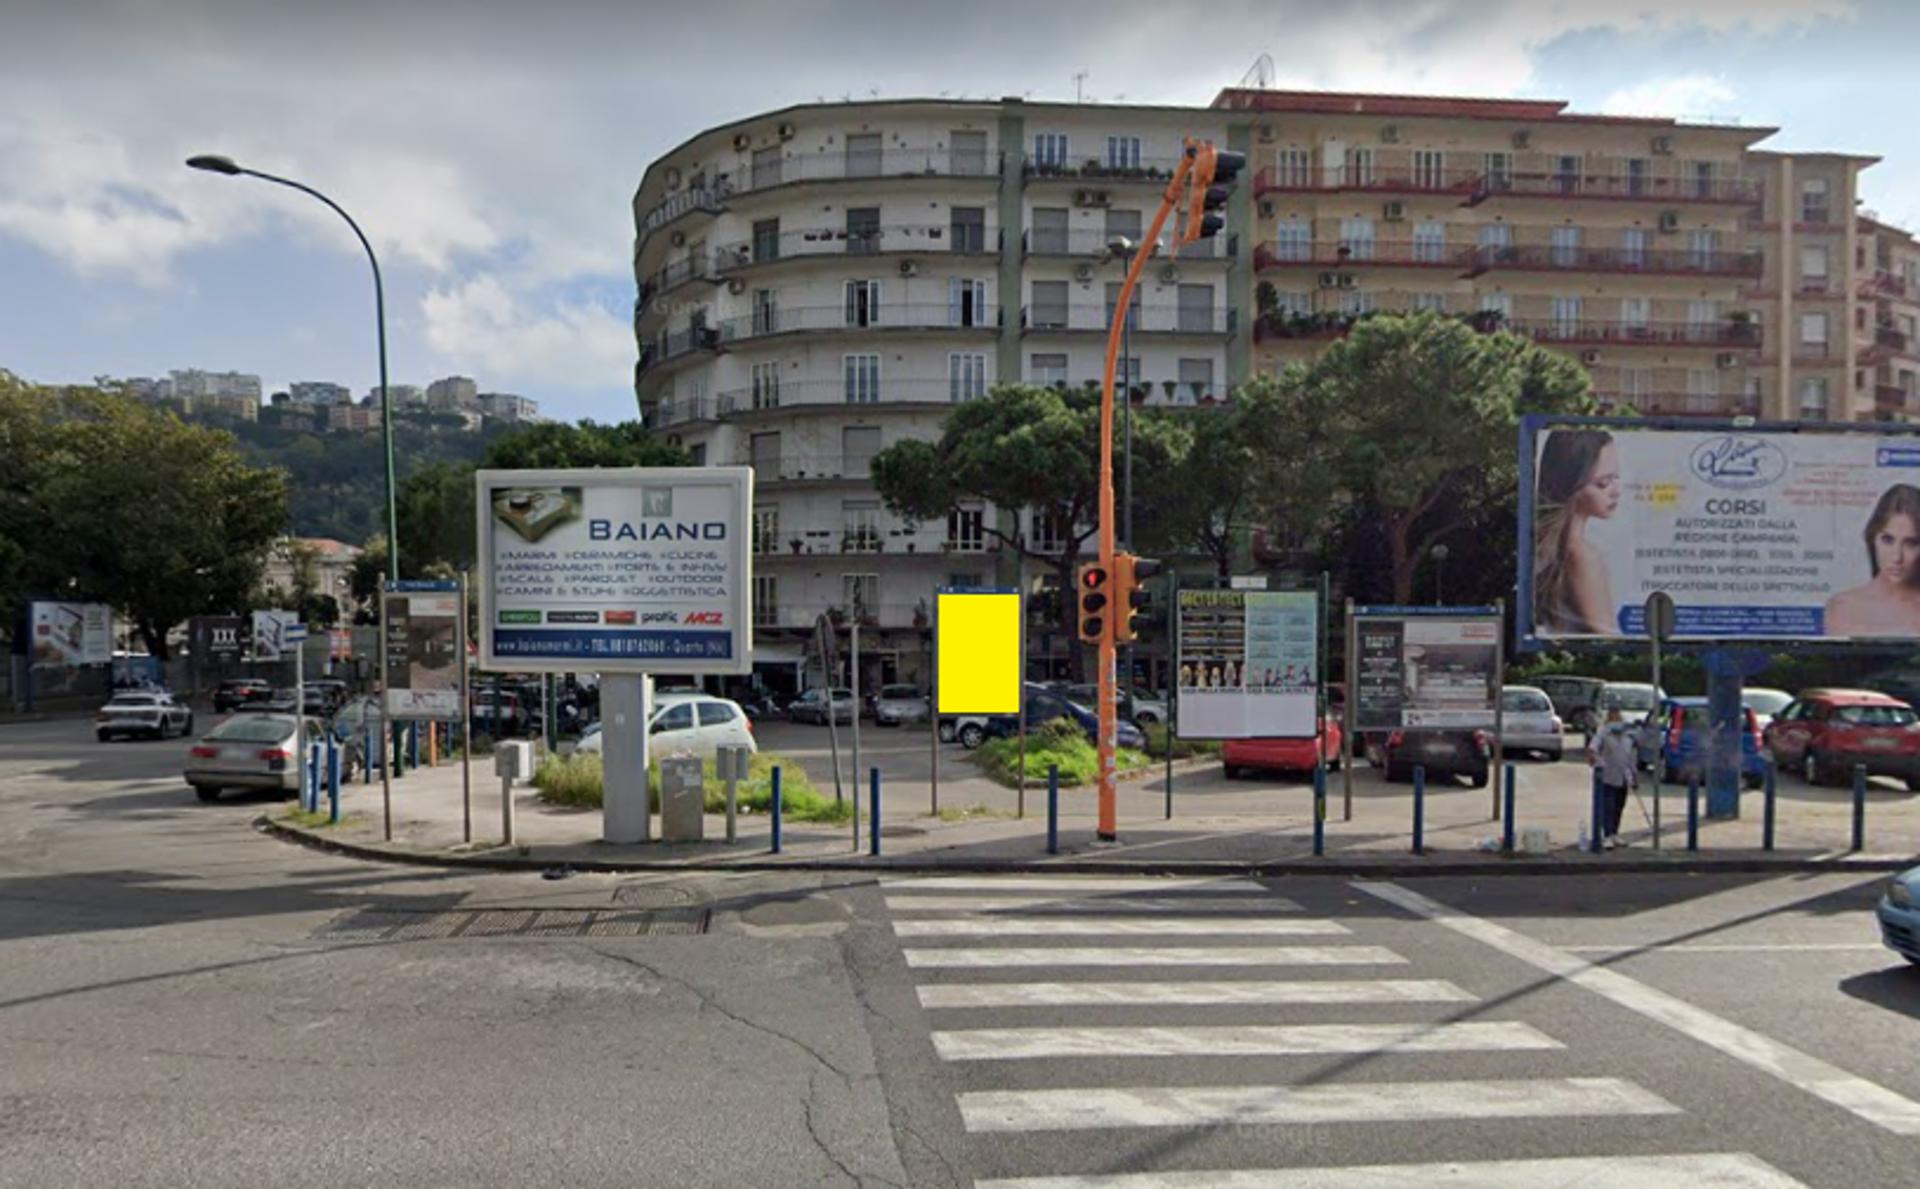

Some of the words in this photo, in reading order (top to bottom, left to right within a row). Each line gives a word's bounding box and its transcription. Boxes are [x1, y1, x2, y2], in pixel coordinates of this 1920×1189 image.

[1705, 499, 1766, 515] CORSI
[1675, 518, 1755, 529] AUTORIZZATI
[1757, 518, 1797, 529] DALLA
[589, 519, 726, 540] BAIANO
[1674, 533, 1729, 543] REGIONE
[667, 551, 718, 560] CUCINE
[571, 574, 636, 583] PARQUET
[655, 575, 723, 583] OUTDOOR
